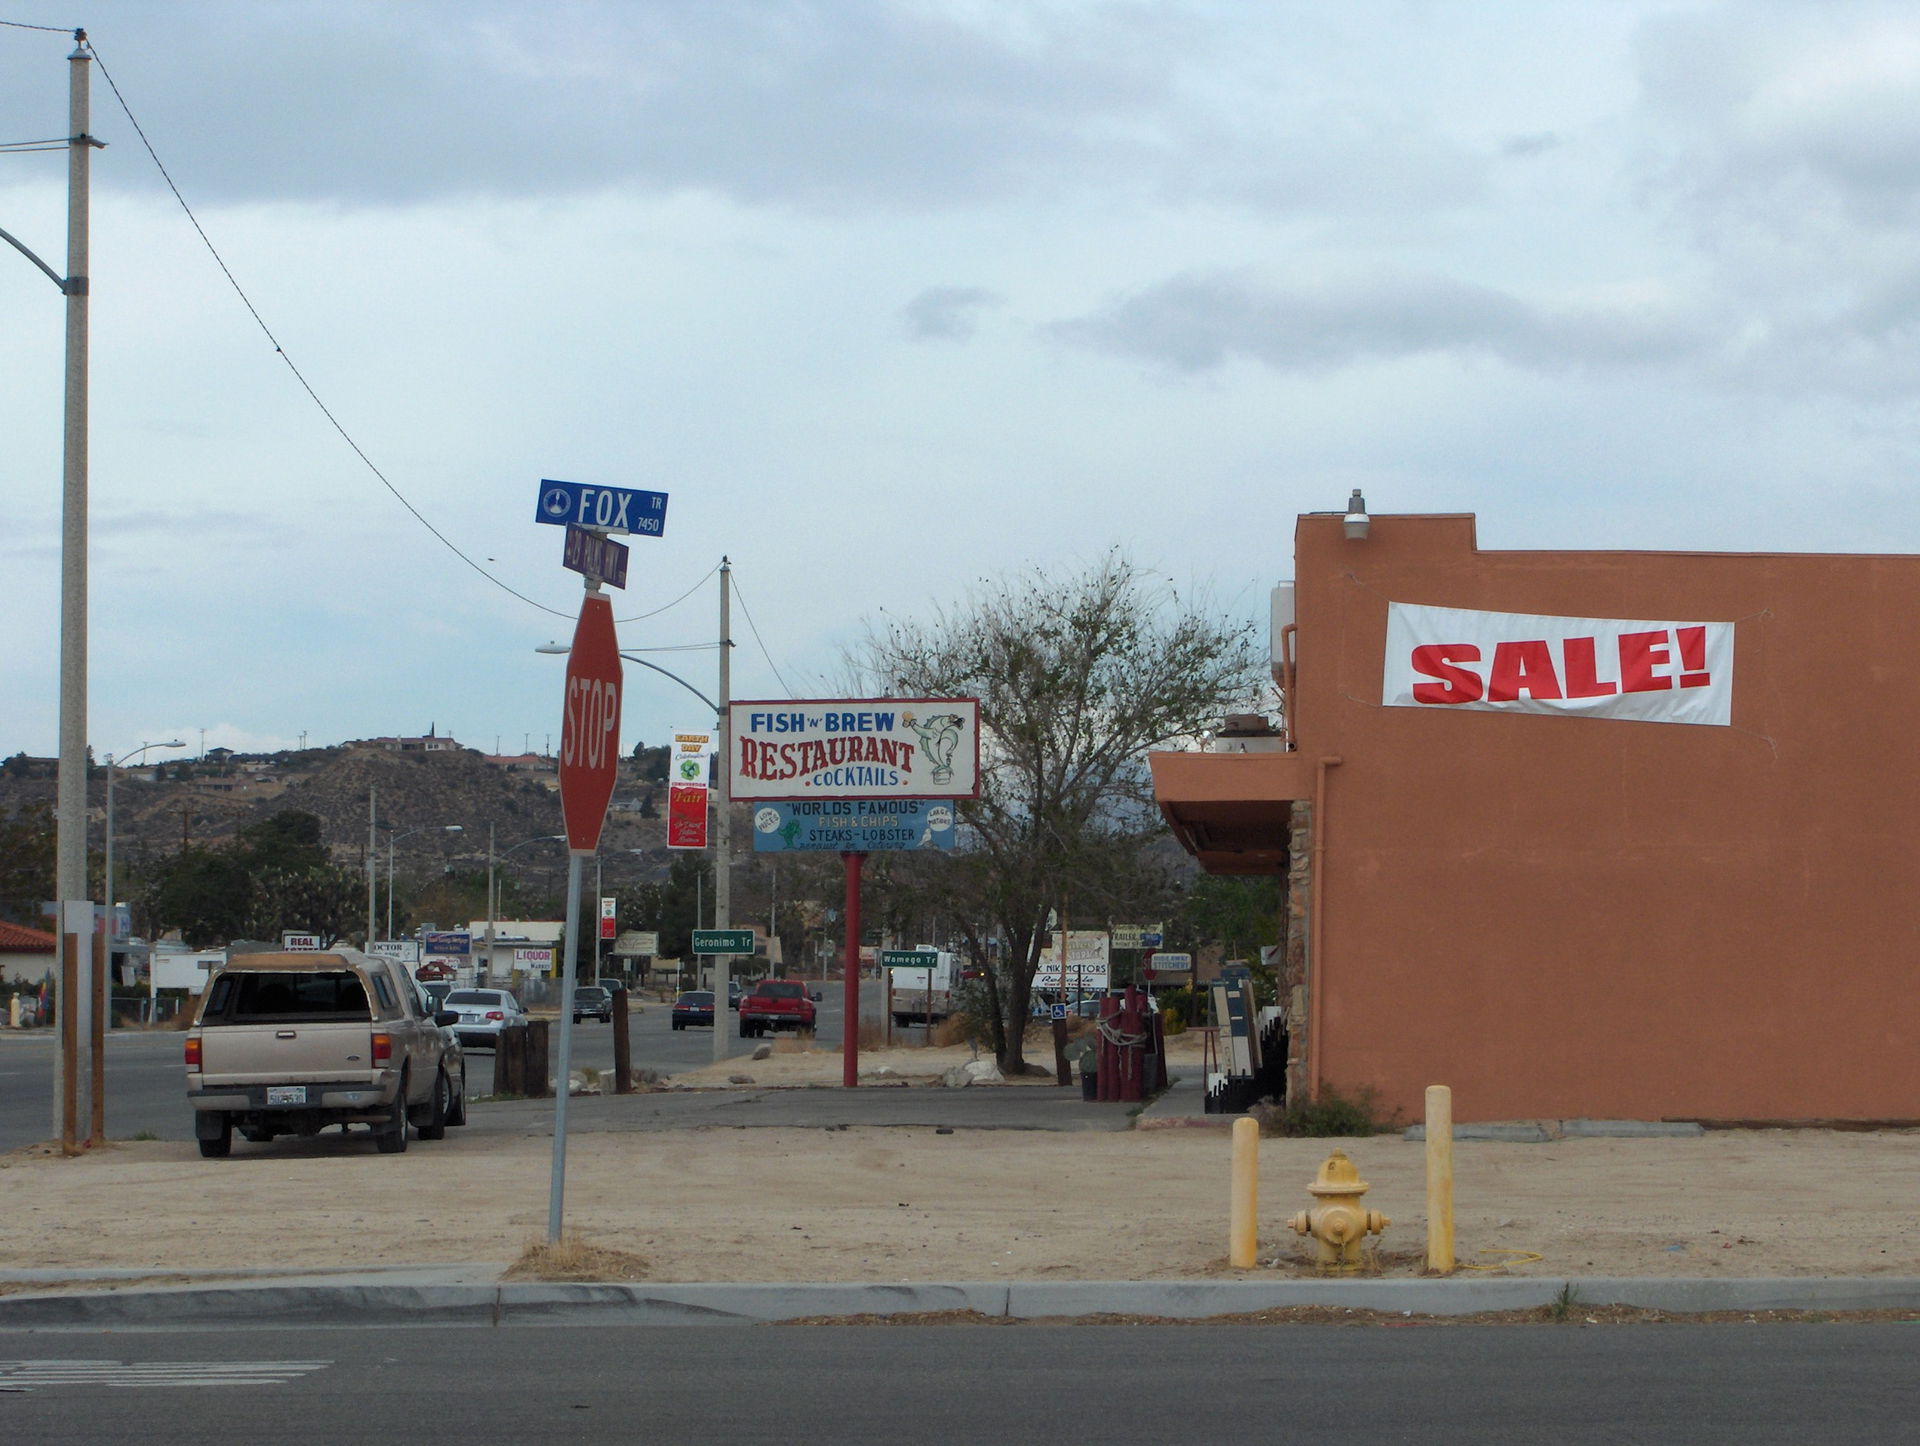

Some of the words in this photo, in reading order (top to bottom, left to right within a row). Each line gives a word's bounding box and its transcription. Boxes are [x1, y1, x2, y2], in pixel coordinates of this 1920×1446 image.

[578, 489, 632, 527] FOX
[651, 496, 662, 509] TR
[638, 517, 659, 531] 7450
[1411, 626, 1710, 704] SALE!
[564, 675, 617, 769] STOP
[751, 713, 804, 732] FISH
[825, 713, 895, 732] BREW
[681, 744, 702, 752] DAY
[739, 736, 915, 781] RESTAURANT
[760, 809, 773, 820] LOW
[930, 809, 948, 817] LARGE
[819, 816, 847, 827] FISH
[851, 816, 858, 827] &
[861, 815, 898, 827] CHIPS
[291, 937, 314, 946] REAL
[695, 937, 735, 947] Geronimo
[742, 937, 751, 947] Tr
[516, 950, 550, 960] LIQUOR
[884, 956, 921, 965] Wamego
[1066, 965, 1106, 973] MOTORS
